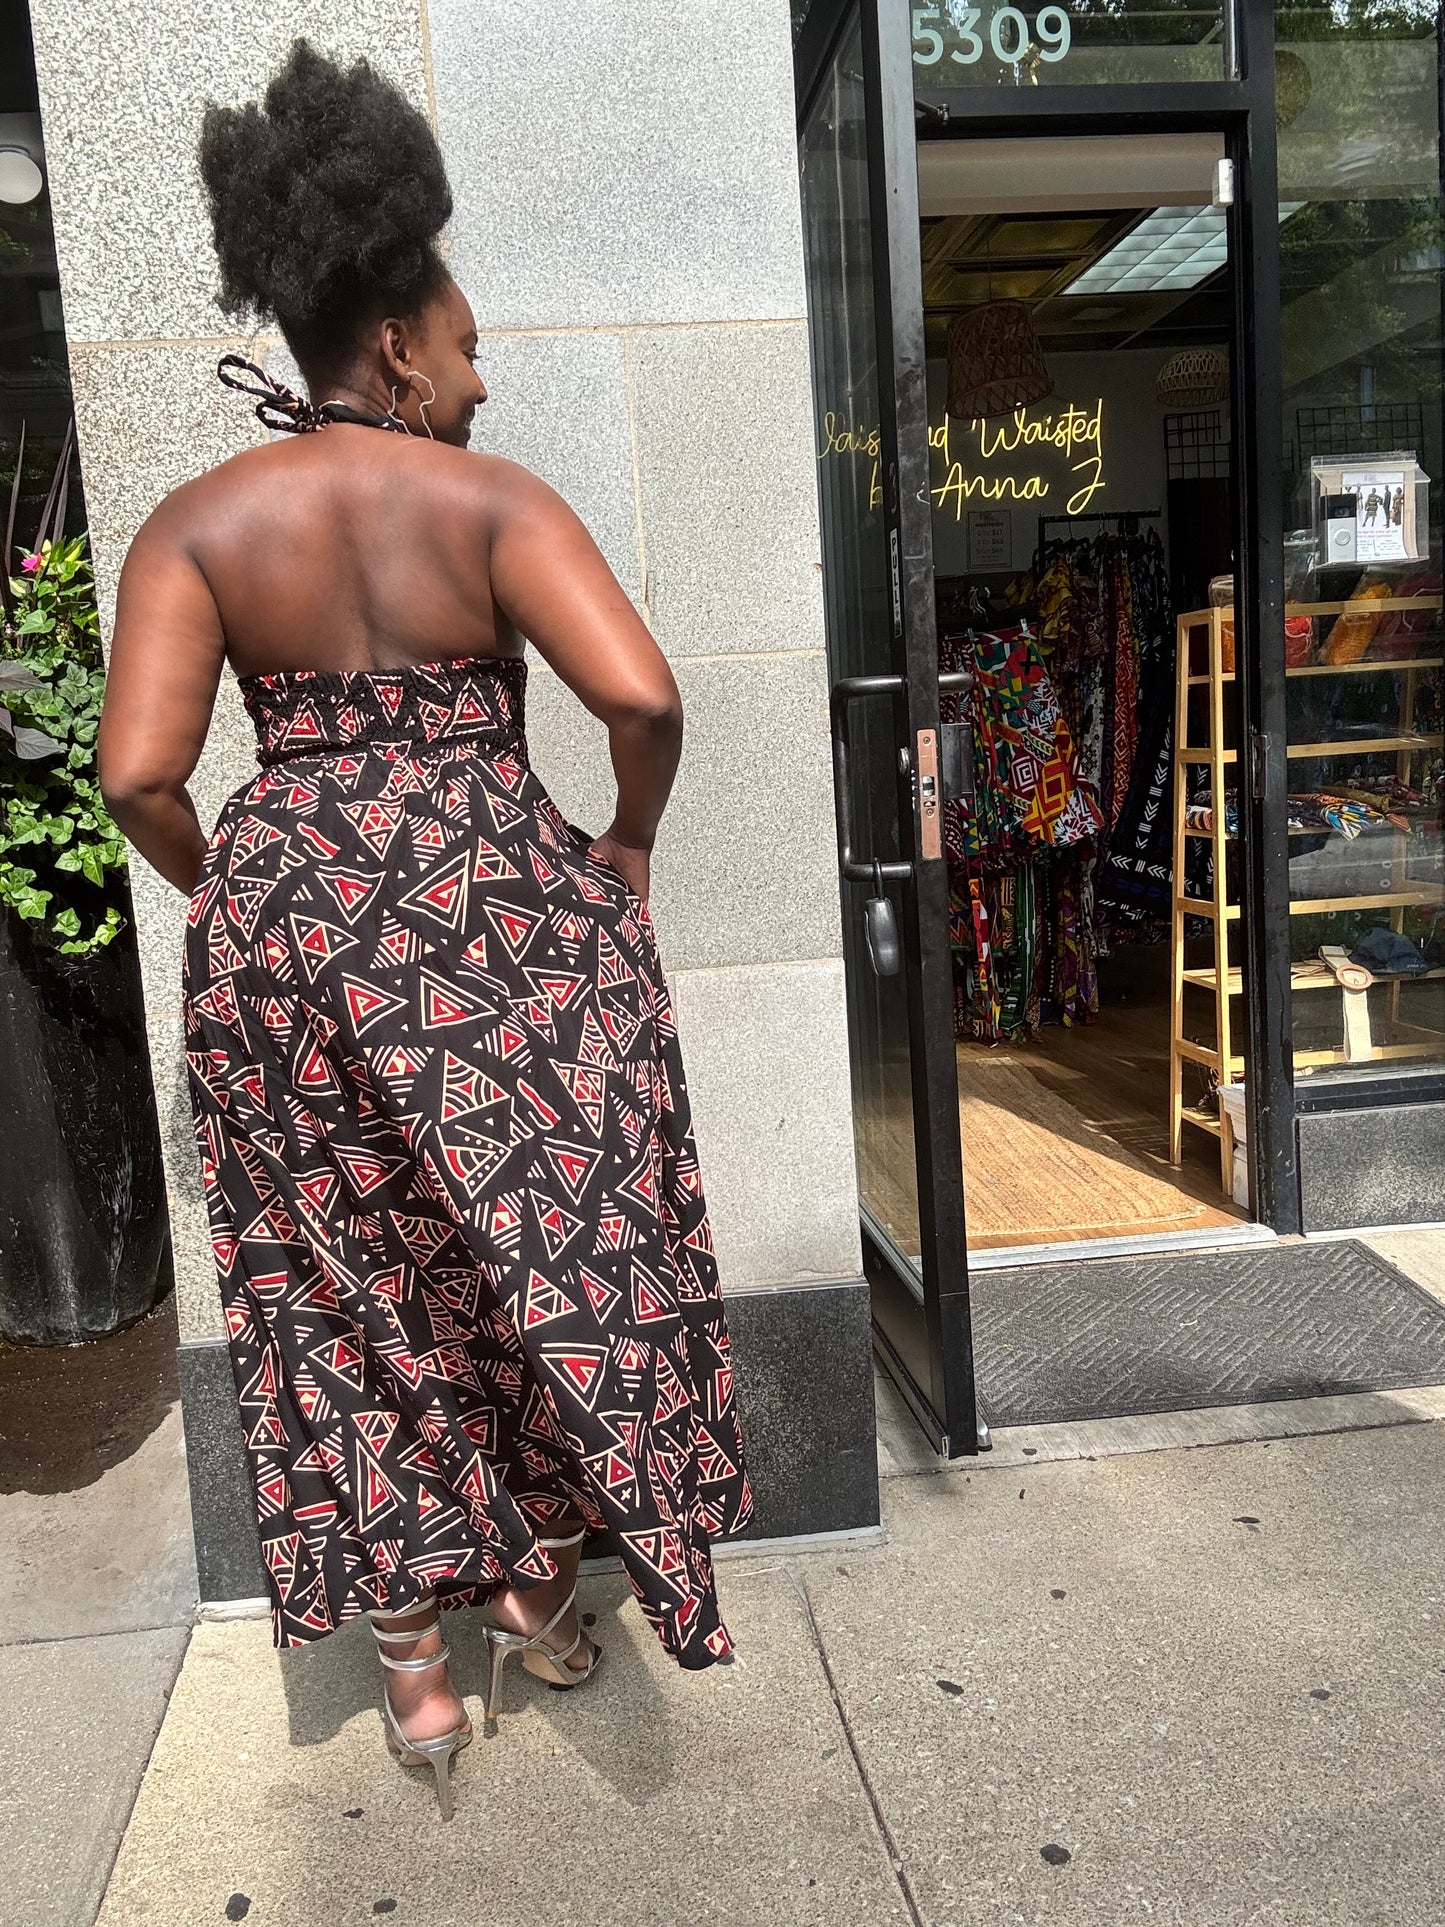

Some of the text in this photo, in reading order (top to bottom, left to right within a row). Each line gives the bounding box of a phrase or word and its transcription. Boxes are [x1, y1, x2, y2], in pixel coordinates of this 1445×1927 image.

[912, 5, 1071, 65] 5309
[971, 398, 1103, 458] Waisted
[931, 462, 1049, 521] Anna
[891, 537, 899, 604] PULL
